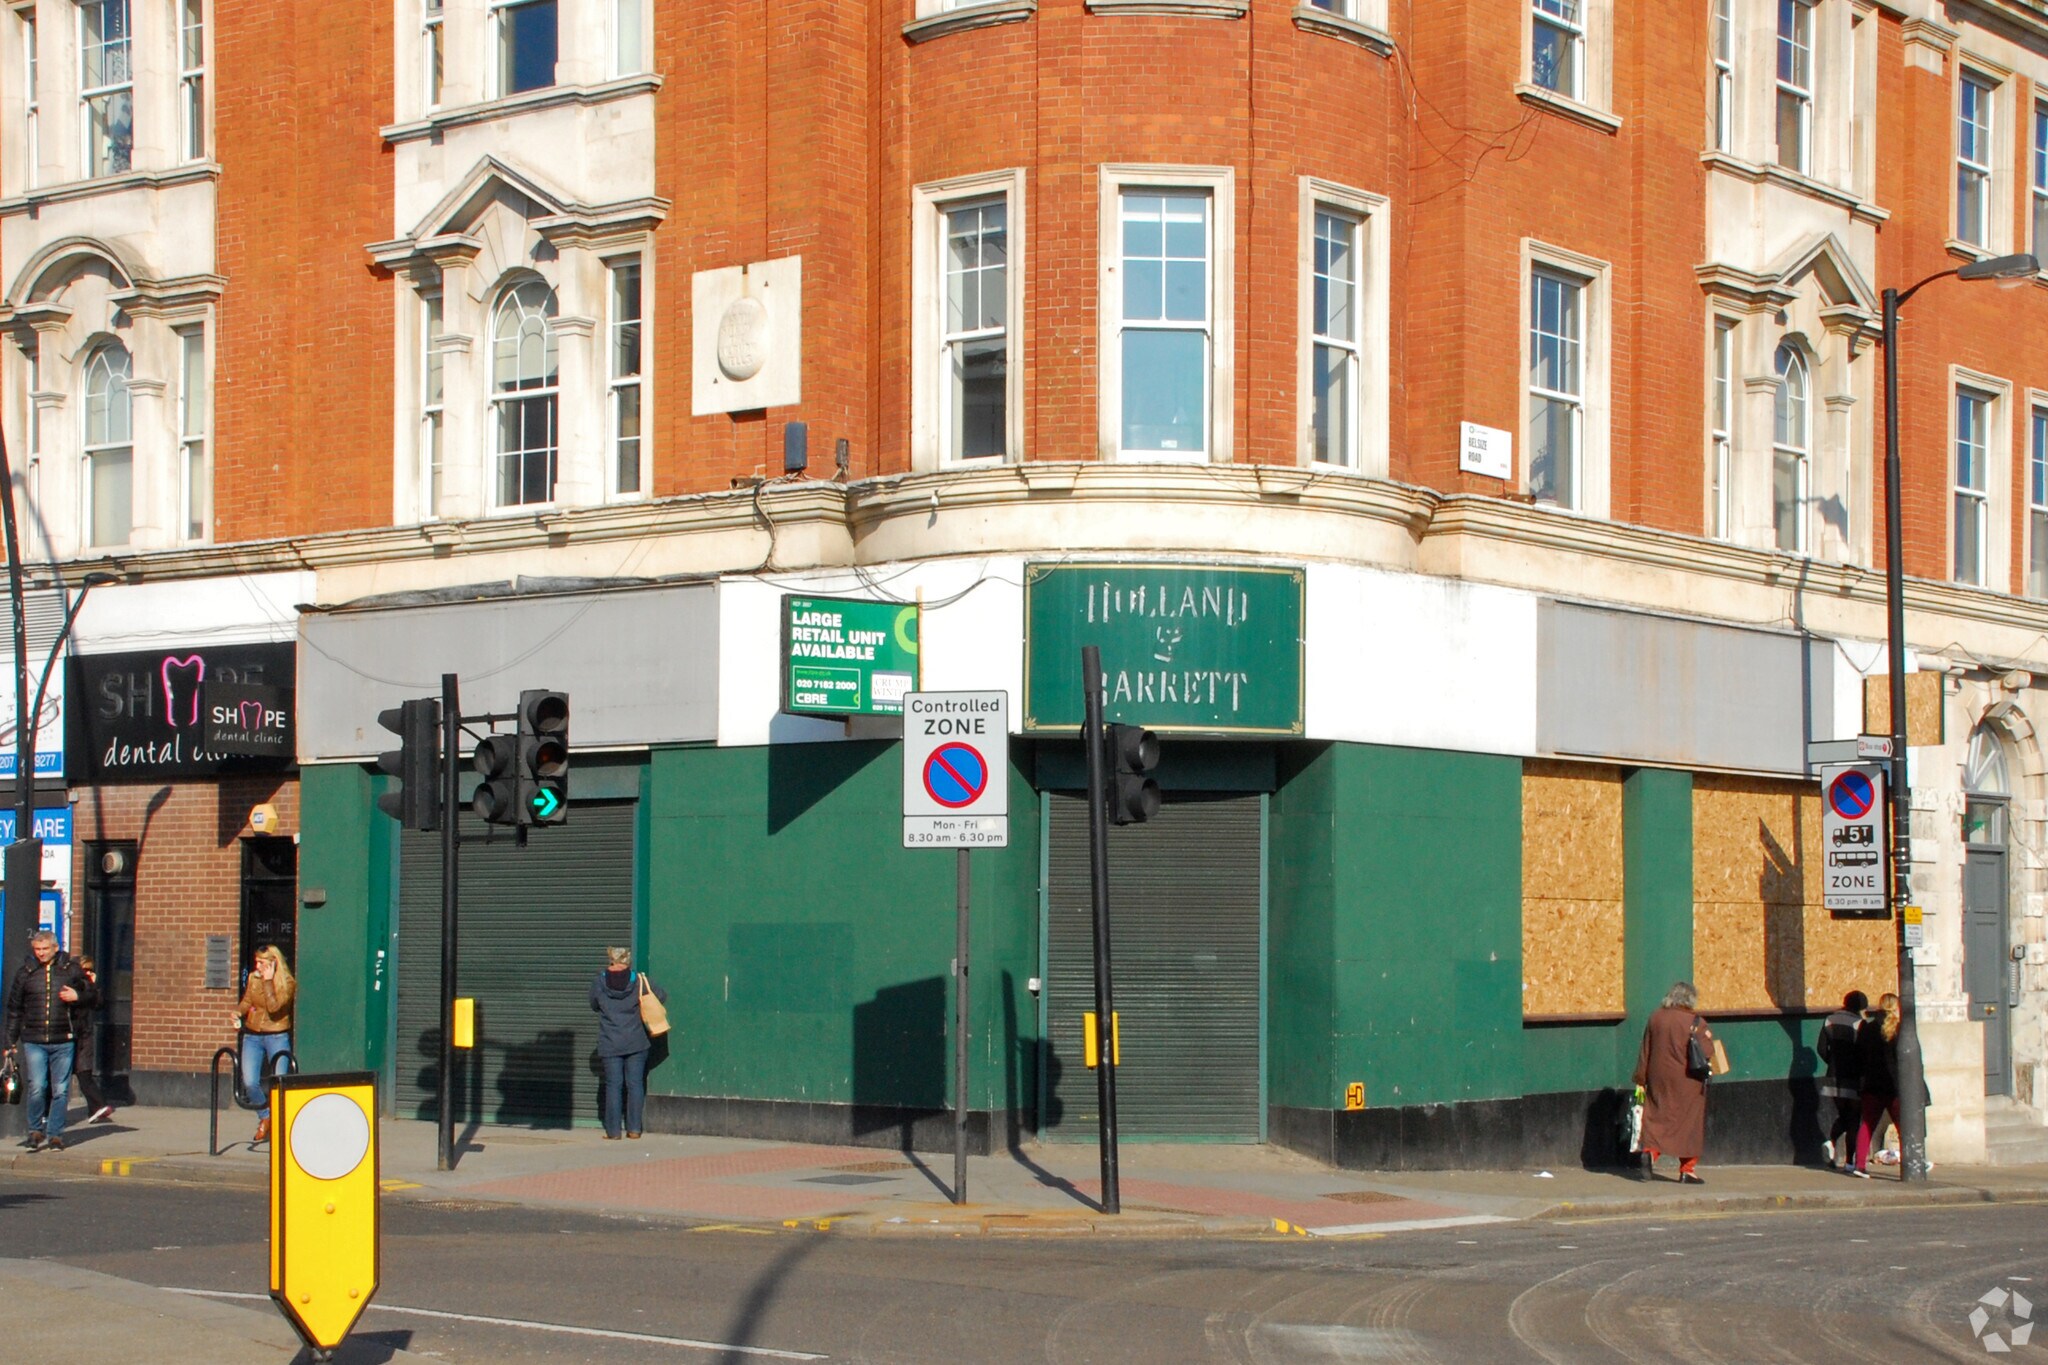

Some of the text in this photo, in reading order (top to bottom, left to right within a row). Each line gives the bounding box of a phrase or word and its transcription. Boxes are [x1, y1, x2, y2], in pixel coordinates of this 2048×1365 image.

[1468, 451, 1482, 463] ROAD
[792, 611, 843, 628] LARGE
[792, 627, 887, 646] RETAIL UNIT
[791, 643, 876, 661] AVAILABLE
[796, 679, 813, 689] 020
[835, 681, 858, 691] 2000
[796, 692, 828, 705] CBRE
[911, 698, 1000, 713] Controlled
[924, 718, 986, 735] ZONE
[213, 730, 284, 744] dental clinic
[104, 733, 181, 767] dental
[933, 820, 955, 830] Mon
[964, 820, 978, 829] Fri
[908, 833, 934, 842] 8.30
[959, 832, 985, 842] 6.30
[987, 834, 1003, 844] pm
[1832, 876, 1875, 888] ZONE
